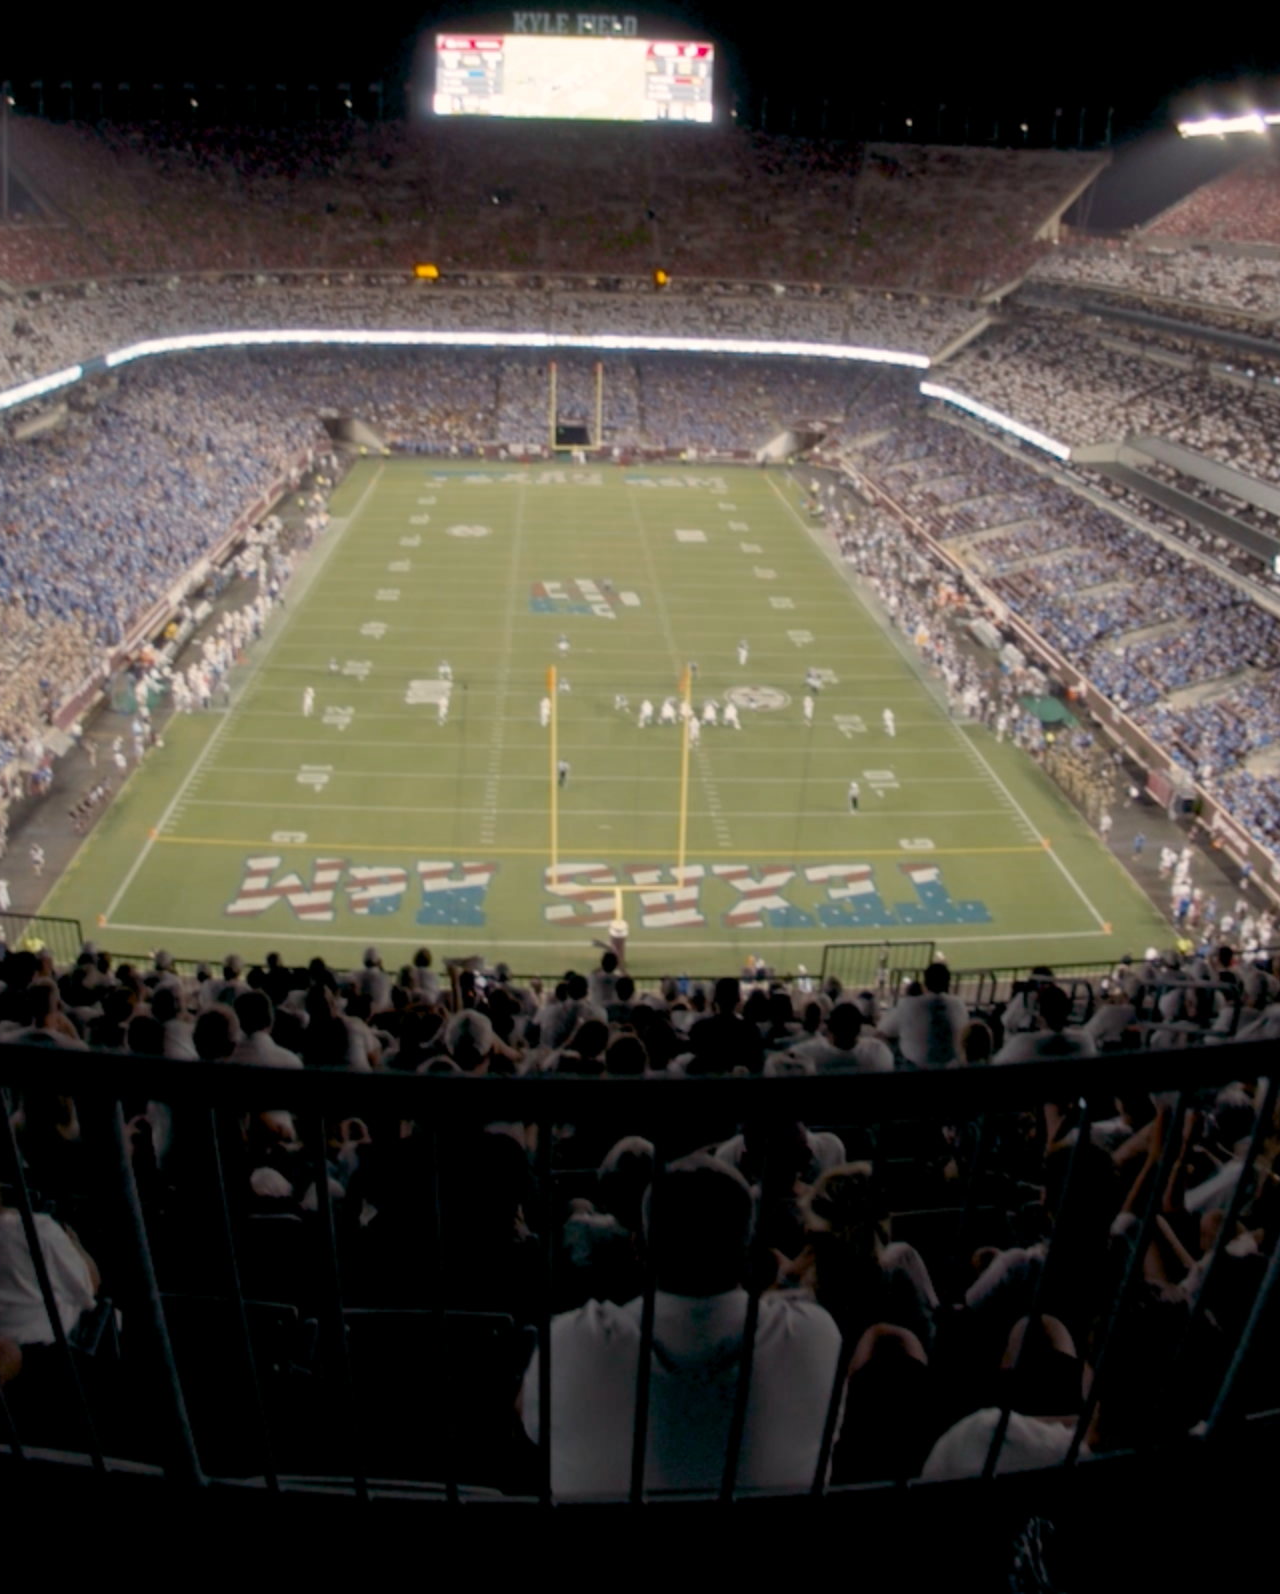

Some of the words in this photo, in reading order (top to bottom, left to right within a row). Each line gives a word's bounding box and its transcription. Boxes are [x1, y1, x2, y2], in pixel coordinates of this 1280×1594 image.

[513, 12, 569, 33] KYLE
[577, 13, 638, 36] FIELD
[224, 856, 498, 928] A&M
[542, 862, 995, 930] TEXAS
